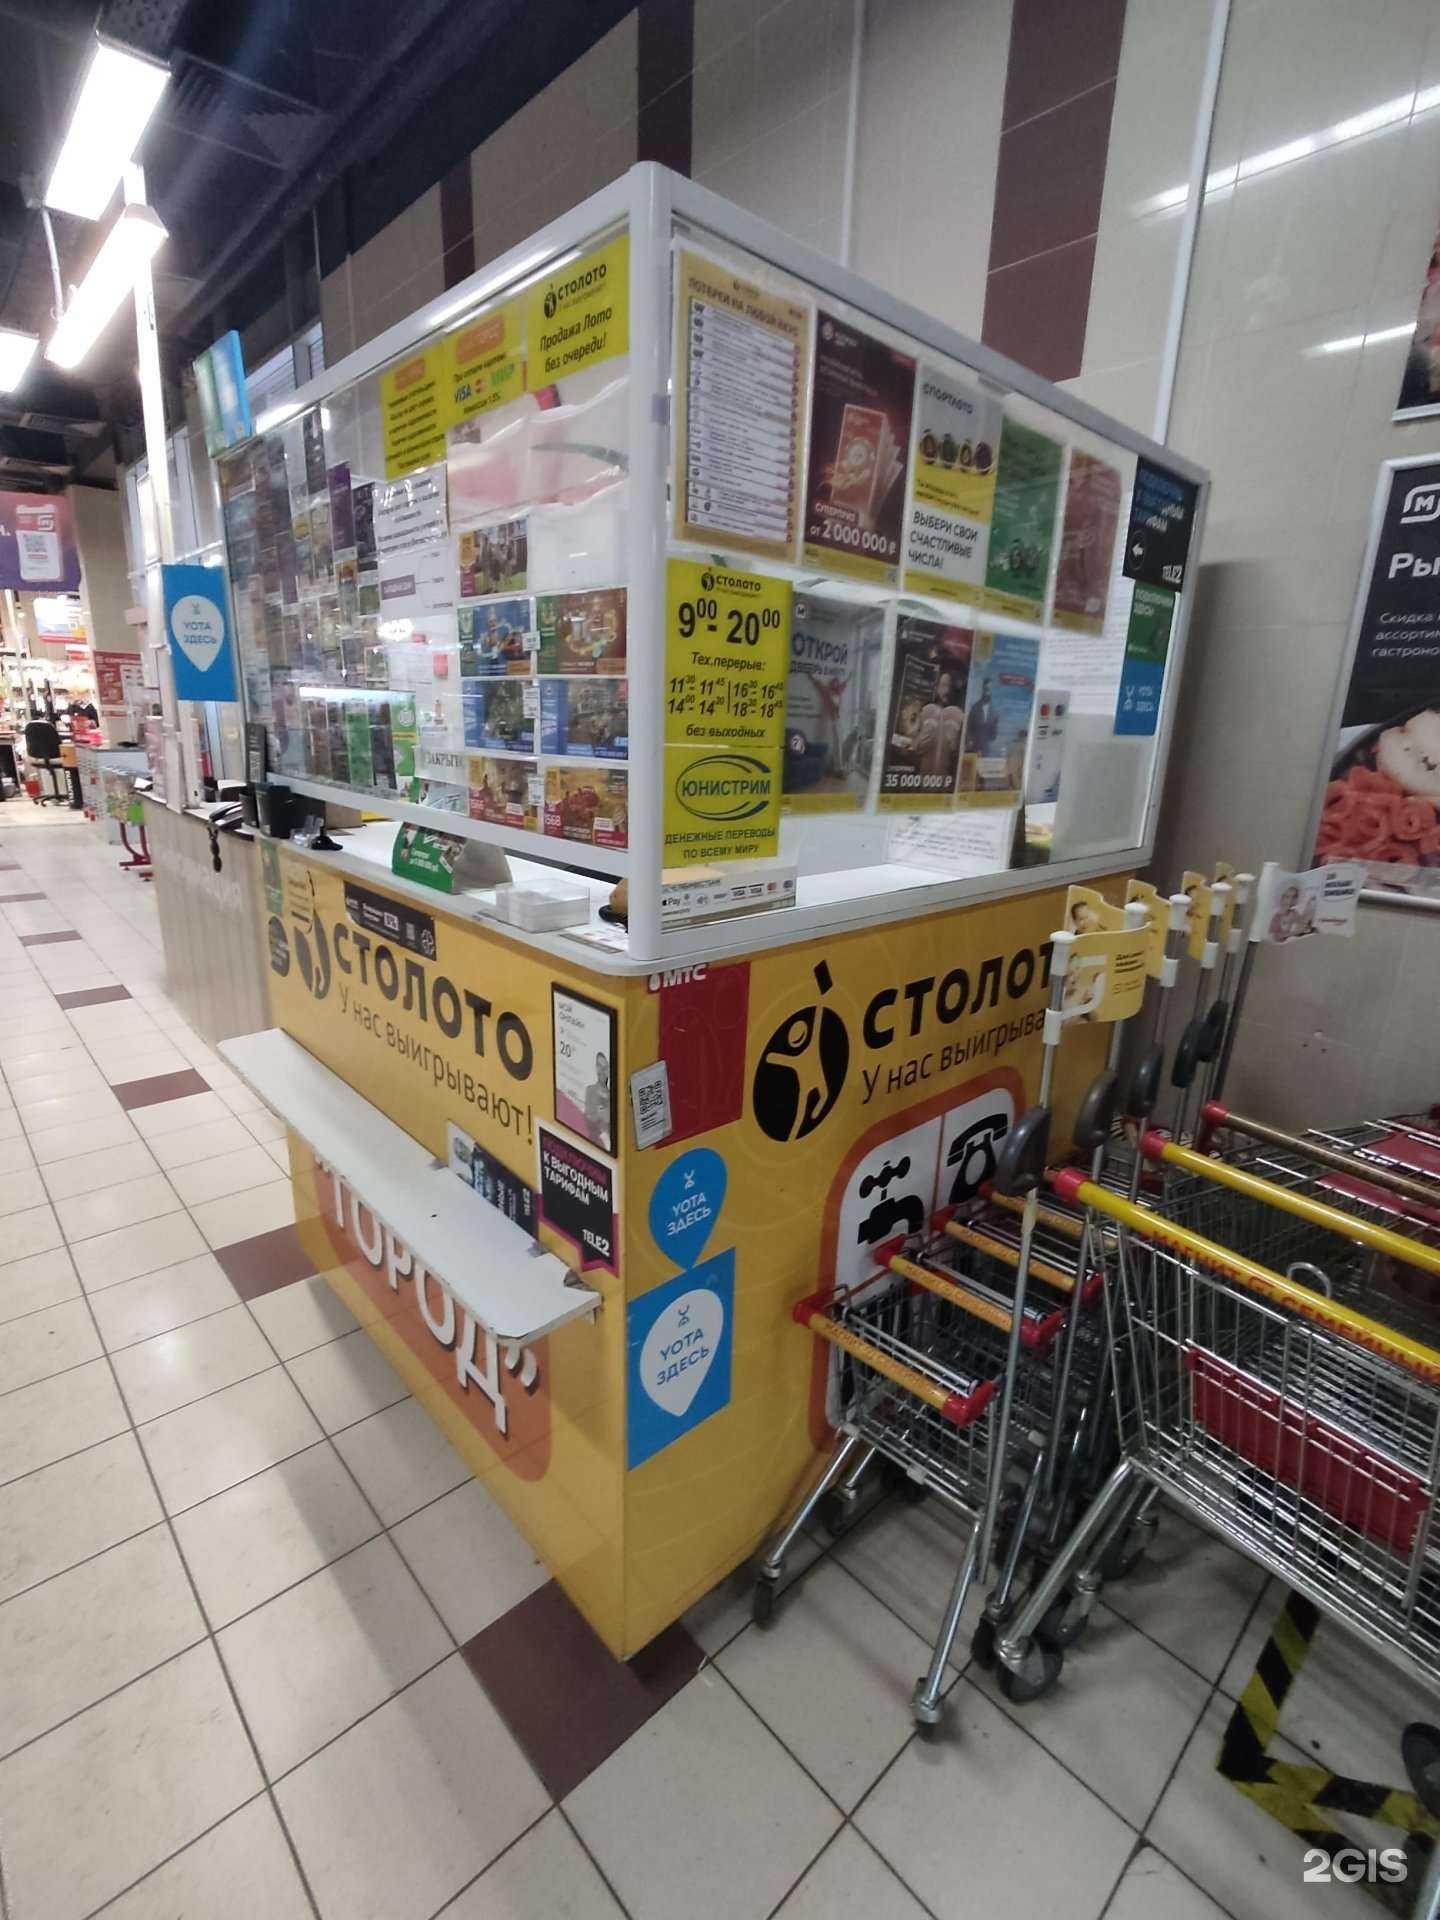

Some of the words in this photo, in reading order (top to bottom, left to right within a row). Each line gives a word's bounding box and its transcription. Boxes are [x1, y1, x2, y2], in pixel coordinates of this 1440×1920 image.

[558, 263, 607, 301] СТОЛОТО
[540, 322, 582, 353] Продажа
[583, 307, 612, 332] Лото
[544, 355, 561, 373] без
[562, 332, 607, 363] очереди!
[822, 519, 832, 539] 2
[833, 523, 861, 547] 000
[862, 531, 888, 554] 000
[912, 511, 953, 535] ВЫБЕРИ
[909, 530, 974, 559] СЧАСТЛИВЫЕ
[716, 575, 761, 592] СТОЛОТО
[182, 620, 211, 630] YOTA
[1379, 612, 1434, 624] Скидка
[183, 633, 217, 645] ЗДЕСЬ
[792, 631, 849, 666] ОТКРОЙ
[686, 723, 706, 737] без
[708, 726, 766, 738] выходных
[681, 780, 772, 798] ЮНИСТРИМ
[885, 774, 899, 787] 35
[900, 774, 920, 788] 000
[922, 774, 943, 788] 000
[664, 831, 723, 845] ДЕНЕЖНЫЕ
[726, 828, 776, 841] ПЕРЕВОДЫ
[683, 849, 698, 859] ПО
[699, 846, 732, 858] ВСЕМУ
[735, 844, 760, 854] МИРУ
[663, 963, 707, 988] МТС
[333, 922, 533, 1081] СТОЛОТО
[863, 942, 1055, 1049] СТОЛОТ
[339, 982, 351, 1013] У
[353, 998, 383, 1040] нас
[386, 1019, 533, 1146] выигрывают!
[862, 1063, 881, 1104] У
[887, 1053, 934, 1094] нас
[543, 1150, 551, 1166] К
[551, 1155, 609, 1204] ВЫГОДНЫМ
[544, 1165, 591, 1206] ТАРИФАМ
[672, 1192, 707, 1217] YOTA
[667, 1206, 712, 1236] ЗДЕСЬ
[582, 1228, 611, 1258] TELE2
[660, 1327, 705, 1361] YOTA
[656, 1346, 710, 1386] ЗДЕСЬ
